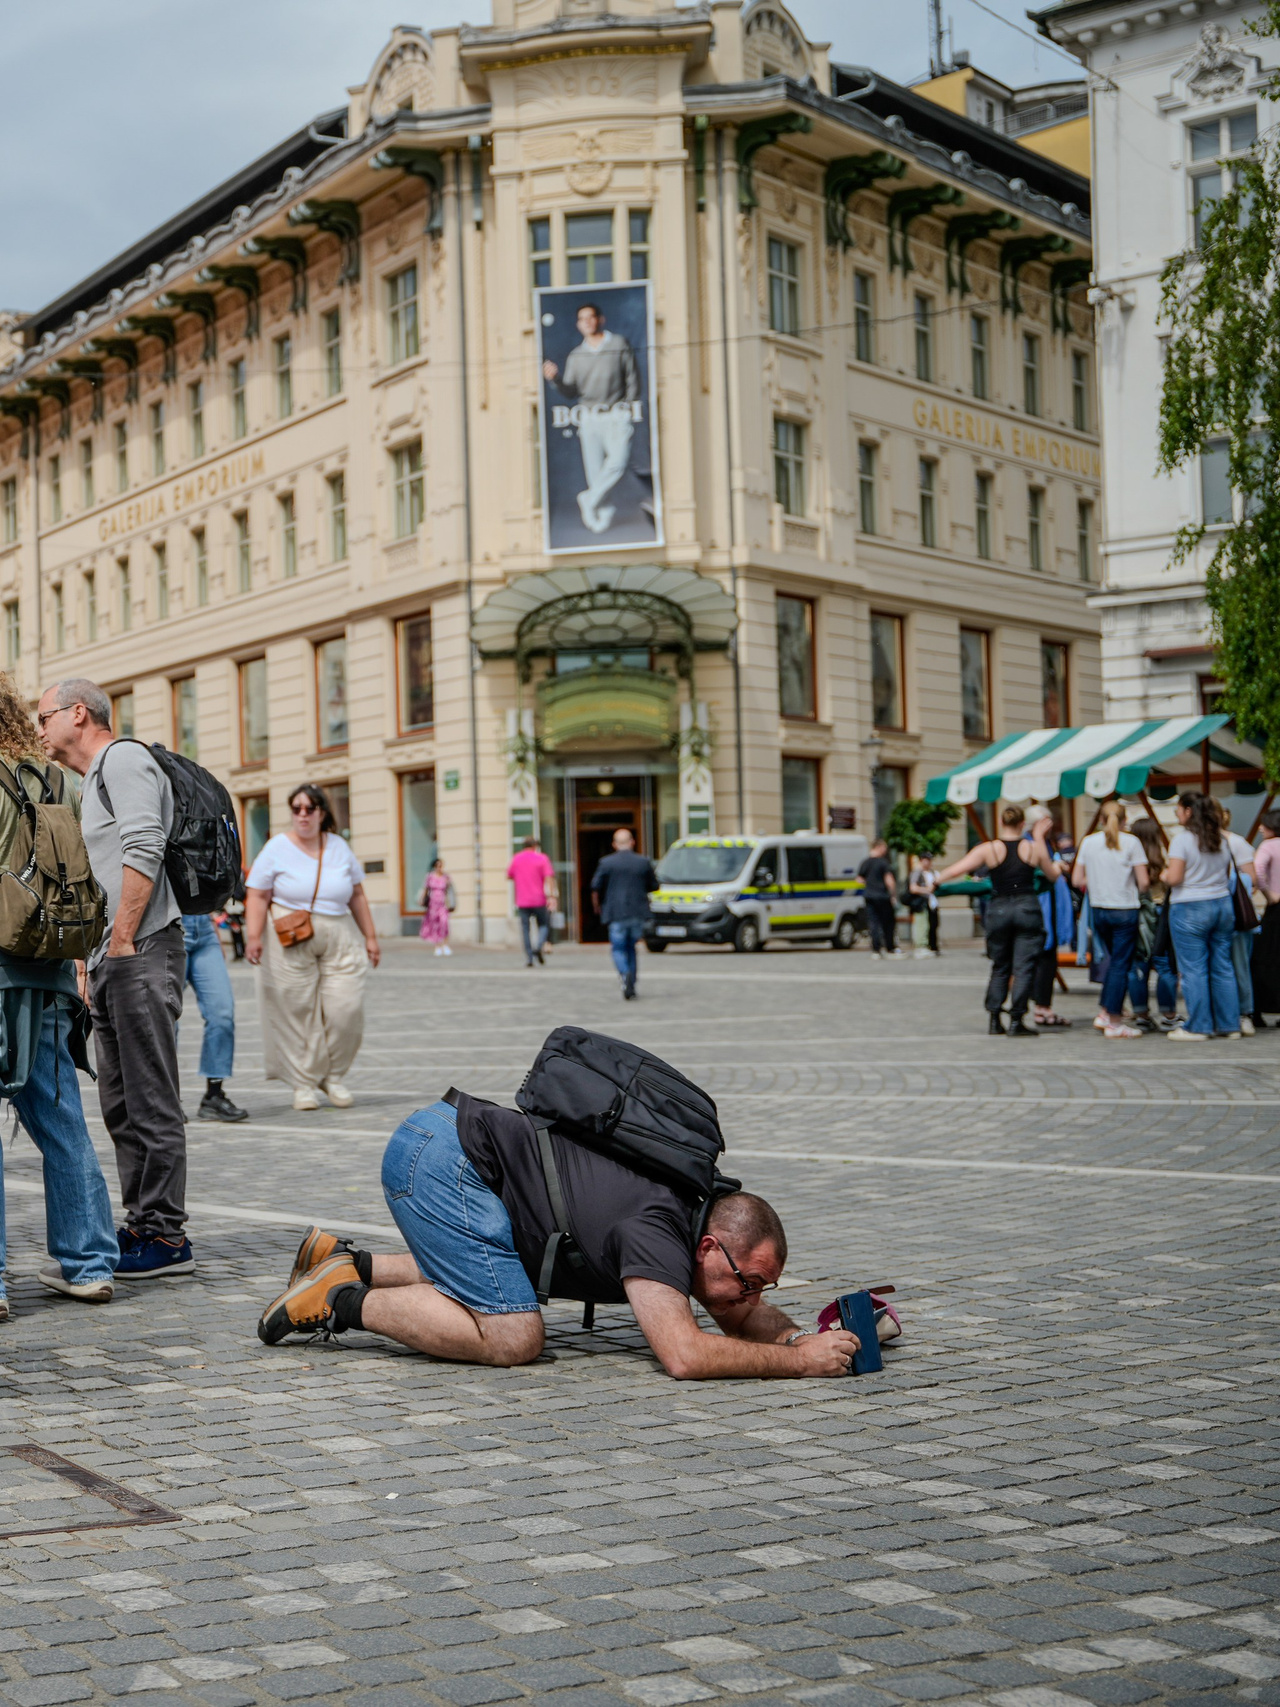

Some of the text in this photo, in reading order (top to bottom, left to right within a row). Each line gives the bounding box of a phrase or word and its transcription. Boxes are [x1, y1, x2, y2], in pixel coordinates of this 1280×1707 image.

[912, 397, 1101, 477] GALERIJA EMPORIUM
[98, 447, 265, 543] GALERIJA EMPORIUM
